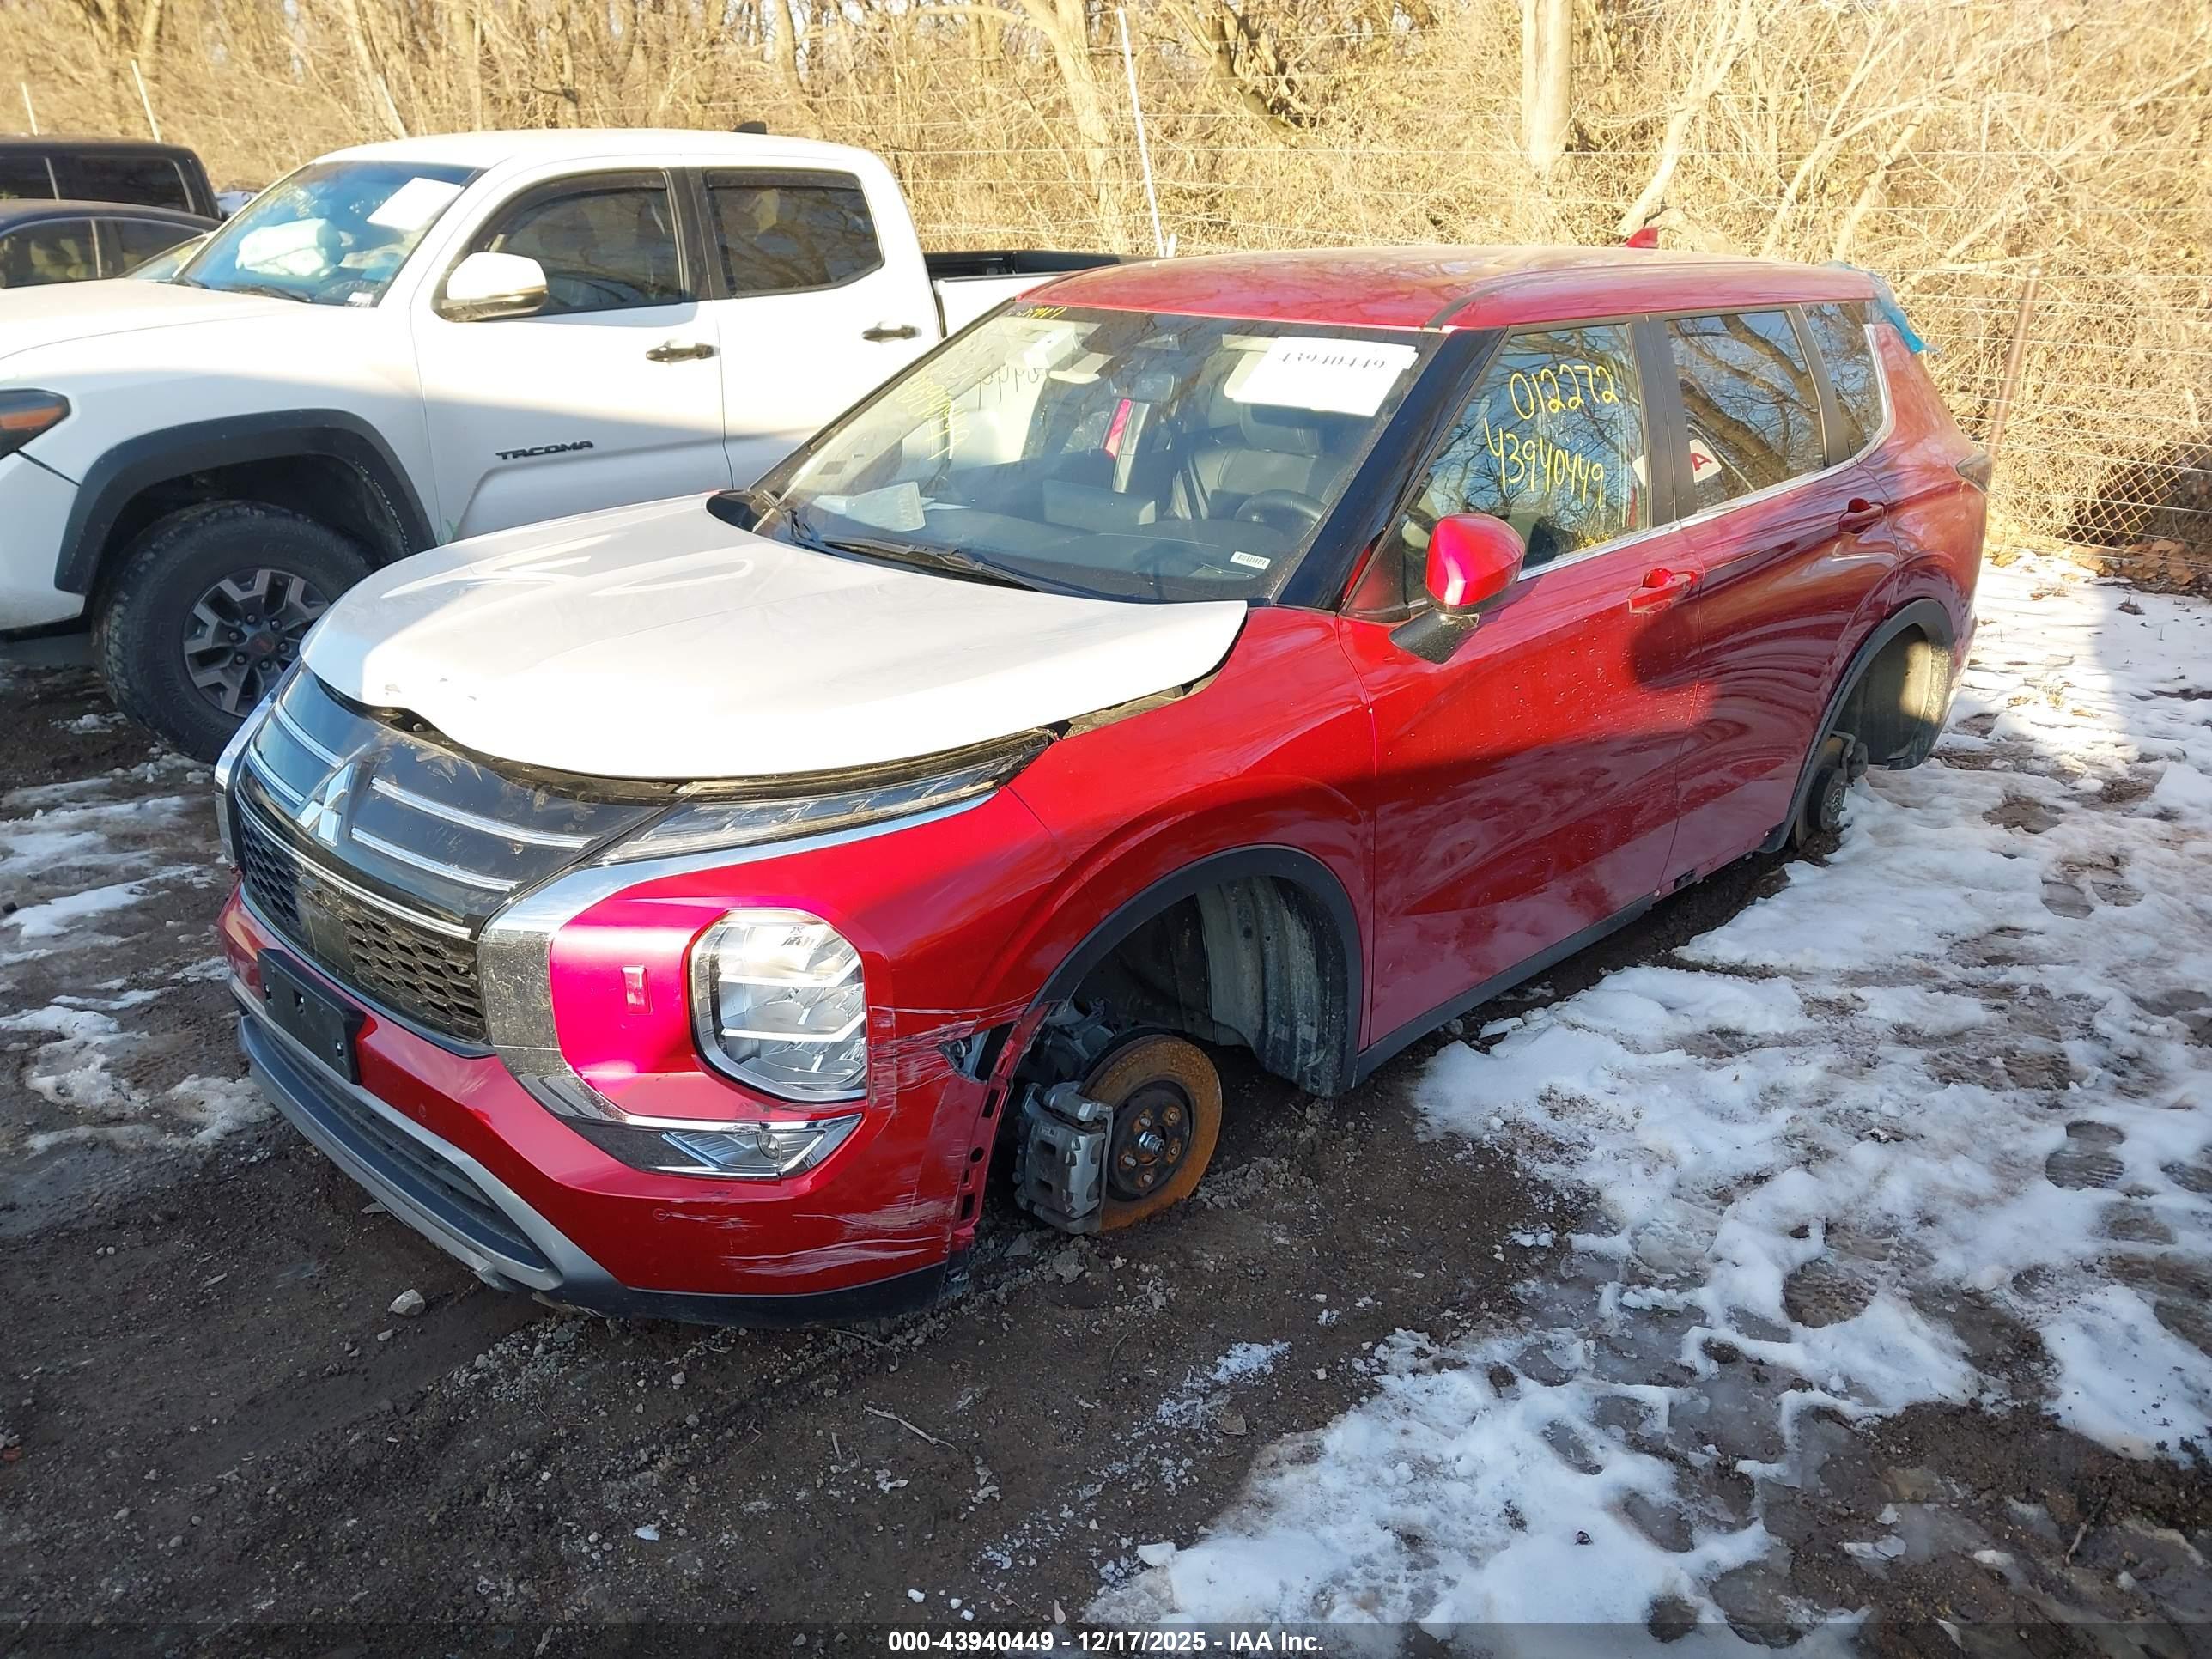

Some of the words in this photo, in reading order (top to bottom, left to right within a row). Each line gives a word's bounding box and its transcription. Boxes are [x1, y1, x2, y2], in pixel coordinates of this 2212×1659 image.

[1510, 363, 1620, 420] 012272
[495, 440, 593, 460] TACOMA
[1484, 416, 1605, 511] 43940449
